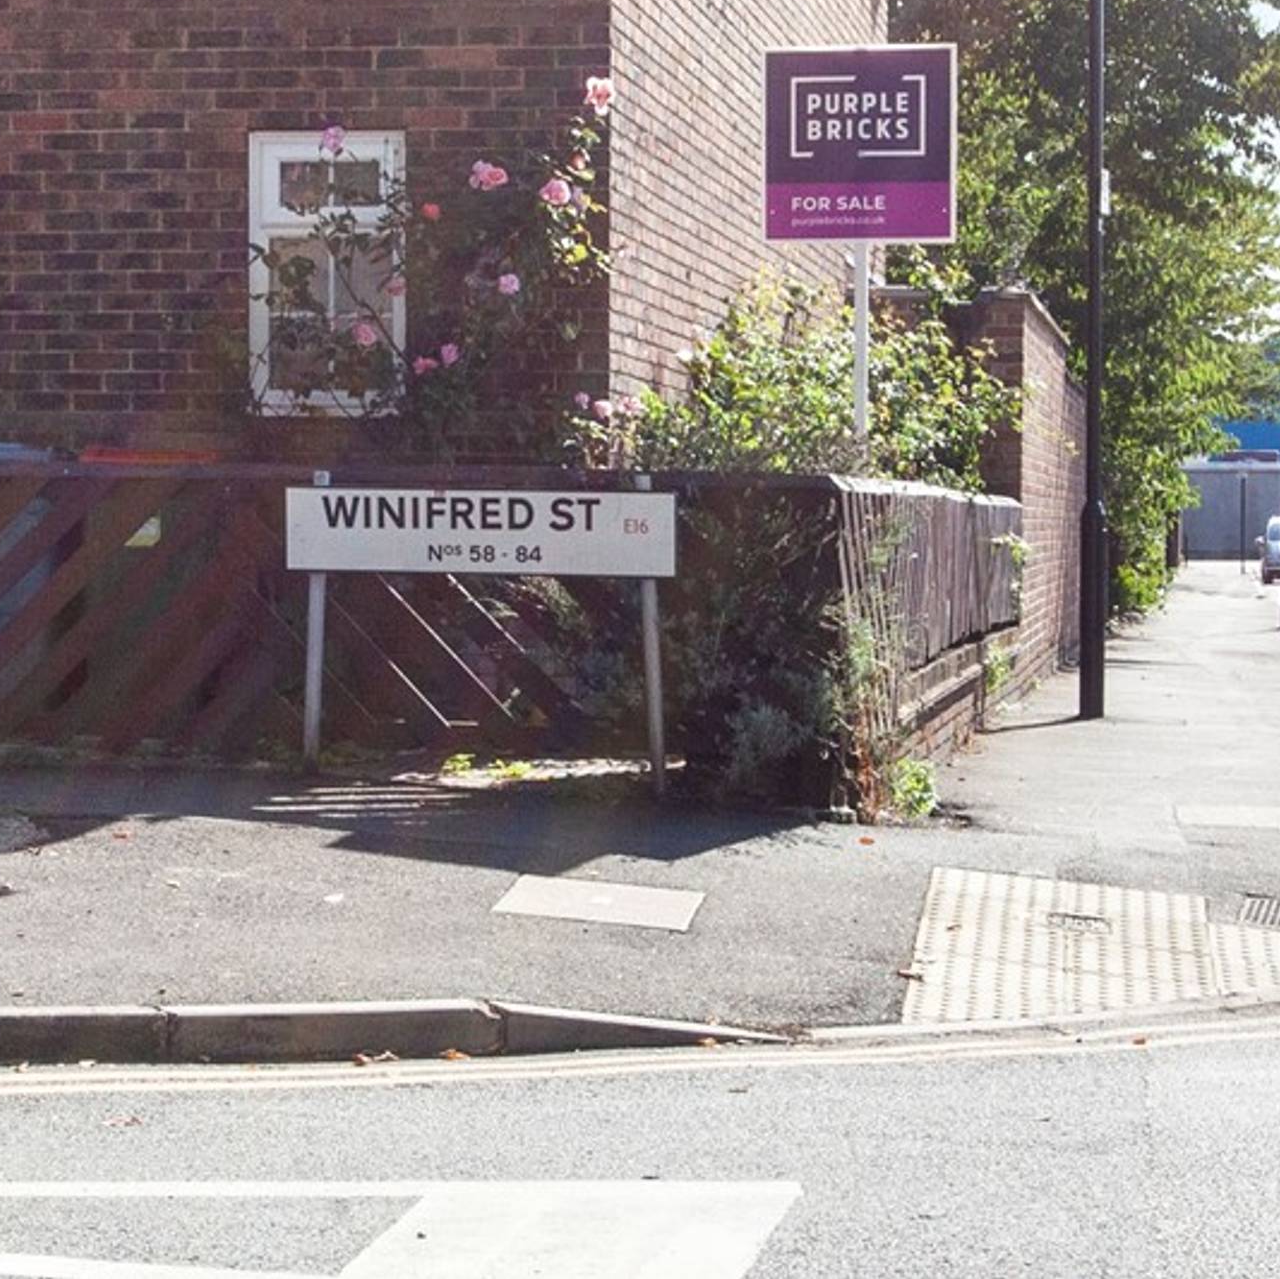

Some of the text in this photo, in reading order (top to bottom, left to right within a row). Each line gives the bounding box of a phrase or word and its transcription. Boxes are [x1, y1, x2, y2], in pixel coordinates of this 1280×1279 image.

[807, 92, 909, 114] PURPLE
[807, 118, 909, 141] BRICKS
[791, 195, 886, 211] FOR SALE
[322, 495, 601, 532] WINIFRED ST
[623, 518, 649, 534] E16
[469, 545, 495, 563] 58
[515, 546, 543, 563] 84
